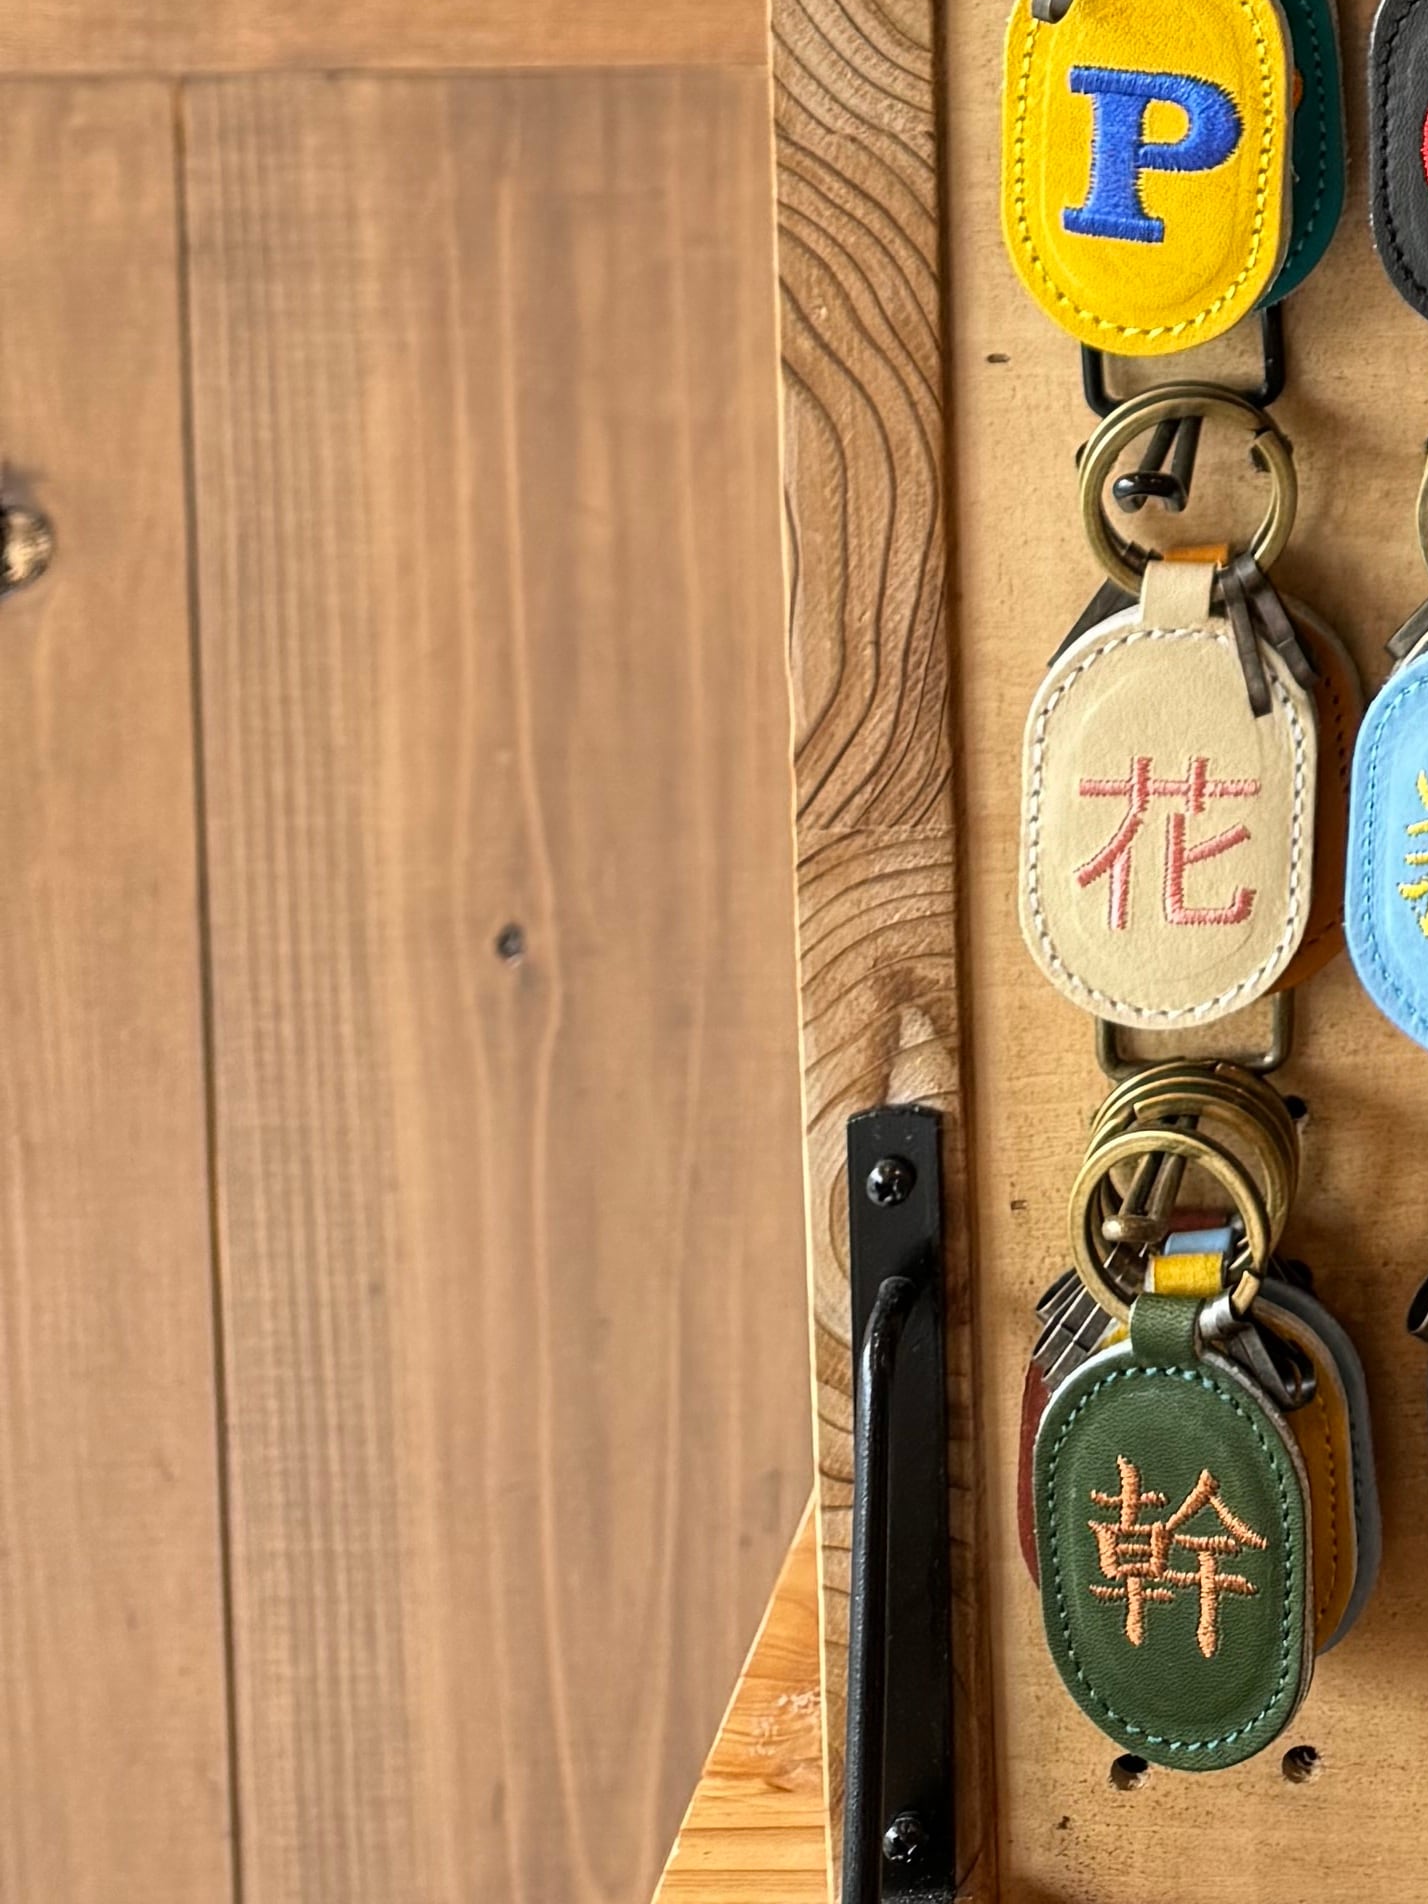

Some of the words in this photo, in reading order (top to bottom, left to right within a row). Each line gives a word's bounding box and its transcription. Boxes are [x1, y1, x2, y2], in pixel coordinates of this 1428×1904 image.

[1061, 64, 1245, 243] P
[1076, 755, 1262, 931] 花
[1088, 1455, 1268, 1658] 幹
